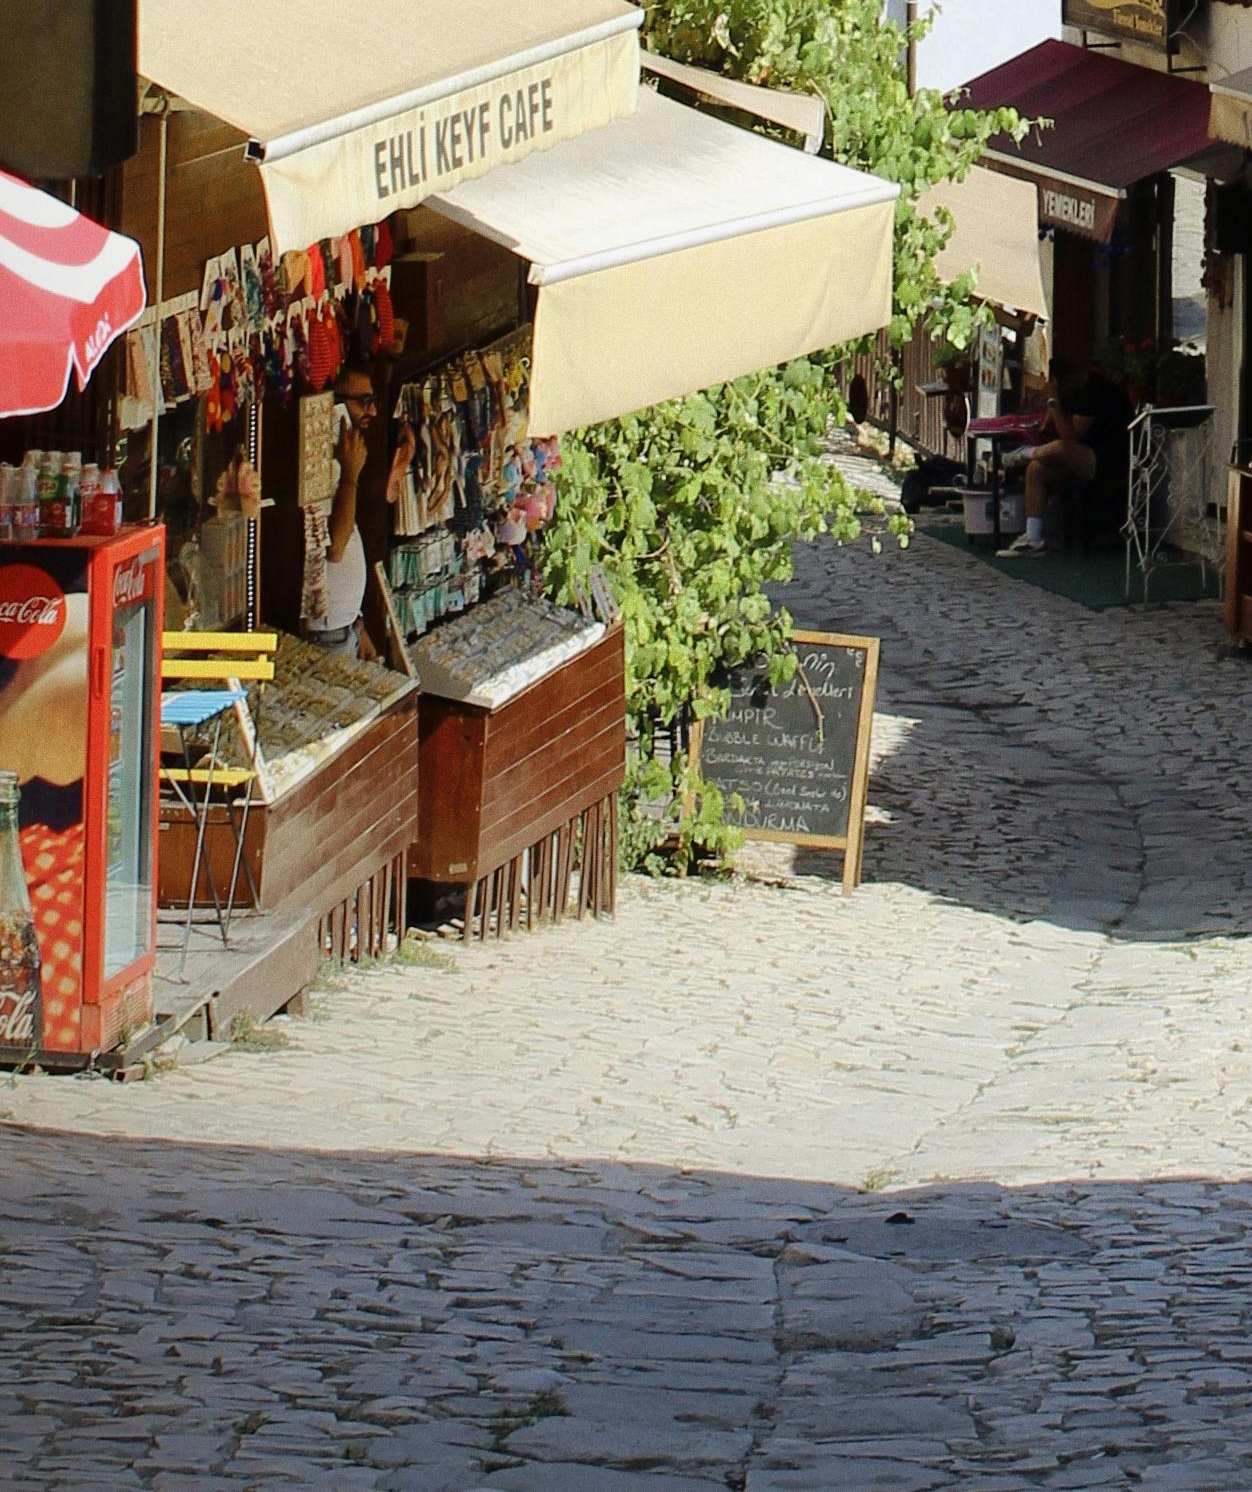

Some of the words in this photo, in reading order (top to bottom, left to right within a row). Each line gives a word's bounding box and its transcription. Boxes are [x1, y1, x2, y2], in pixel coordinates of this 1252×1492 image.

[373, 110, 428, 199] EHLİ
[435, 101, 491, 176] KEYF
[499, 77, 554, 151] CAFE
[1043, 188, 1096, 230] YEMEKLERİ
